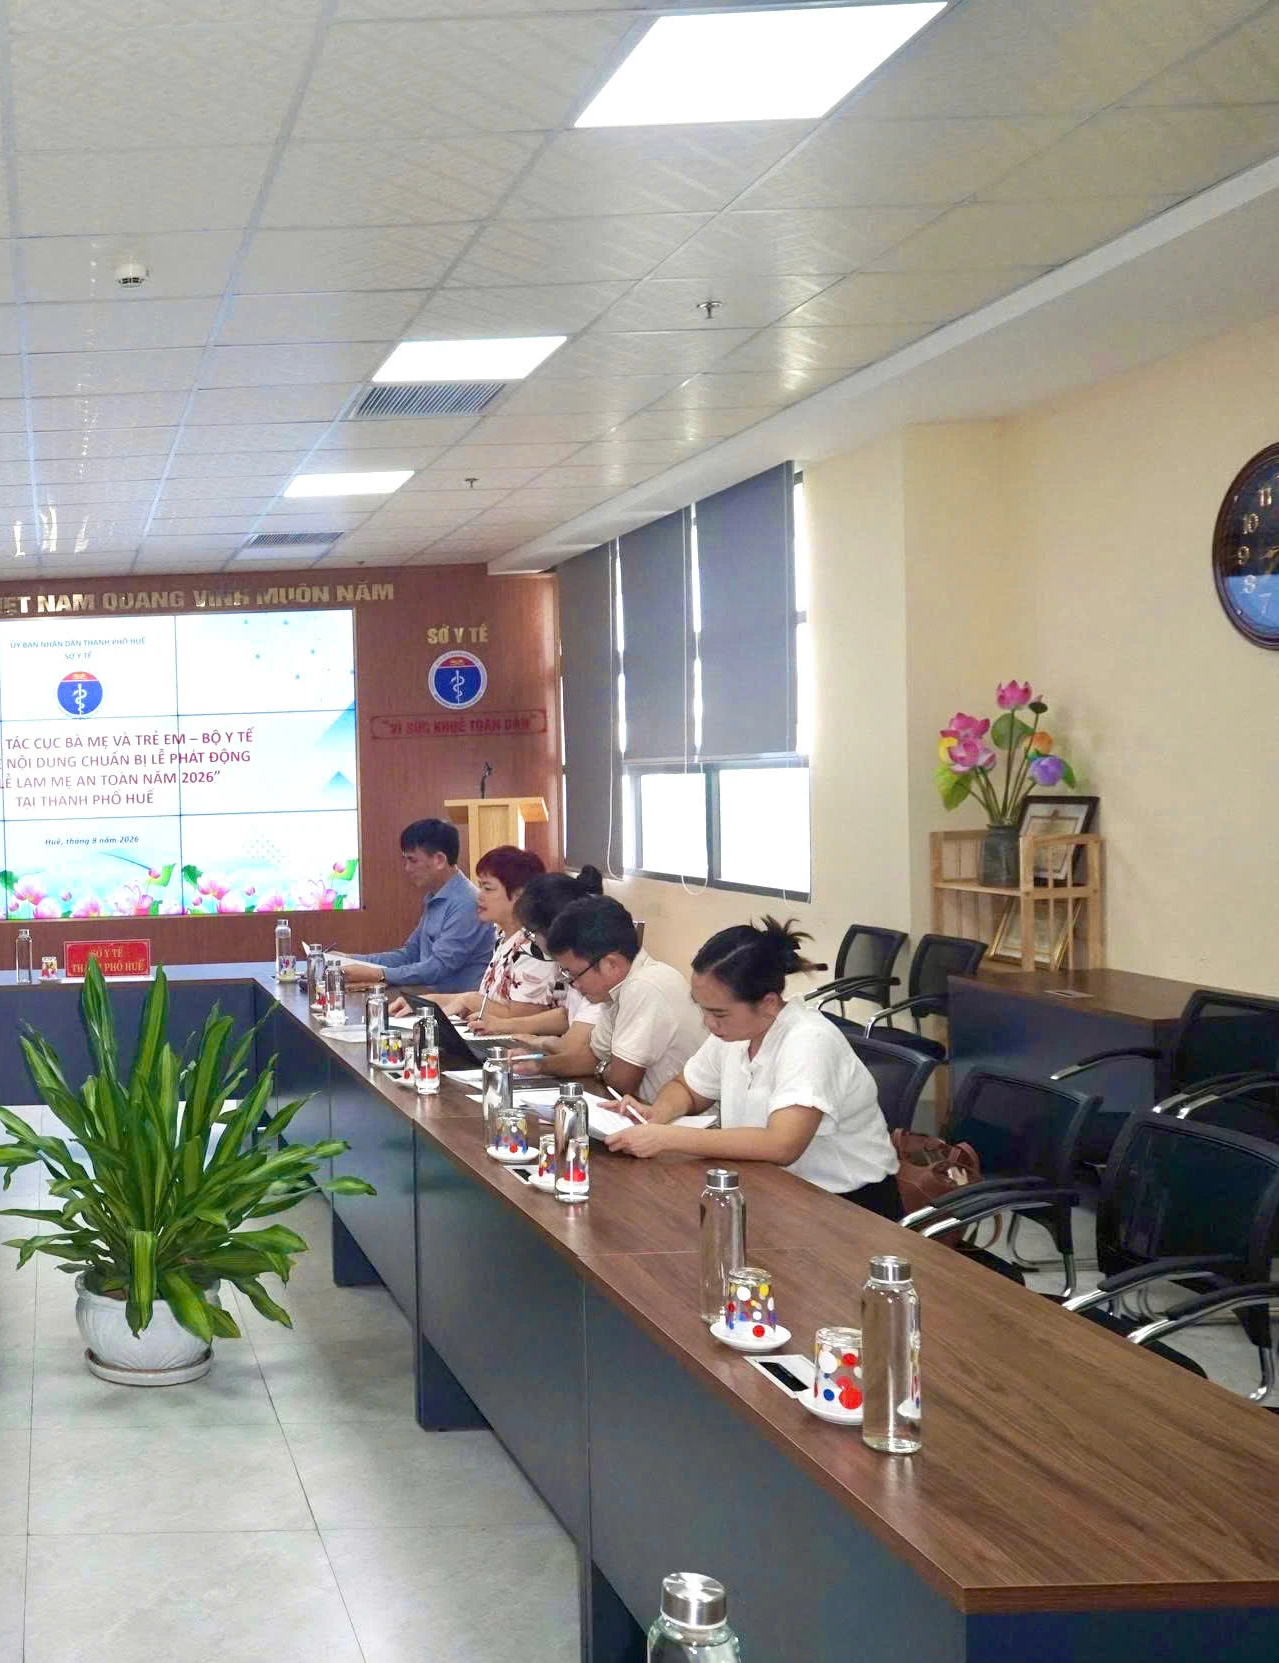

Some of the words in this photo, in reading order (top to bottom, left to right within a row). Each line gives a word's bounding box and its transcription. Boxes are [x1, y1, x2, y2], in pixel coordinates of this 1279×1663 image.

[1238, 546, 1250, 565] 9
[37, 593, 95, 613] NAM
[102, 590, 185, 611] QUANG
[256, 583, 330, 605] MUÔN
[336, 580, 395, 602] NĂM
[453, 627, 465, 643] Y
[22, 640, 38, 648] BAN
[5, 735, 30, 749] TÁC
[33, 736, 61, 750] CỤC
[65, 734, 83, 748] BÀ
[87, 735, 108, 749] MẸ
[163, 733, 186, 745] EM
[202, 729, 221, 745] BỘ
[225, 731, 234, 744] Y
[237, 726, 255, 742] TẾ
[6, 755, 31, 770] NỘI
[36, 756, 77, 768] DUNG
[133, 754, 147, 768] BỊ
[151, 749, 165, 765] LỄ
[169, 748, 205, 765] PHÁT
[208, 747, 250, 764] ĐỘNG
[50, 775, 72, 789] MẸ
[76, 775, 96, 787] AN
[142, 770, 176, 784] NĂM
[15, 795, 35, 809] TẠI
[119, 835, 139, 843] 2026
[104, 949, 111, 958] Y
[125, 959, 144, 971] HUẾ
